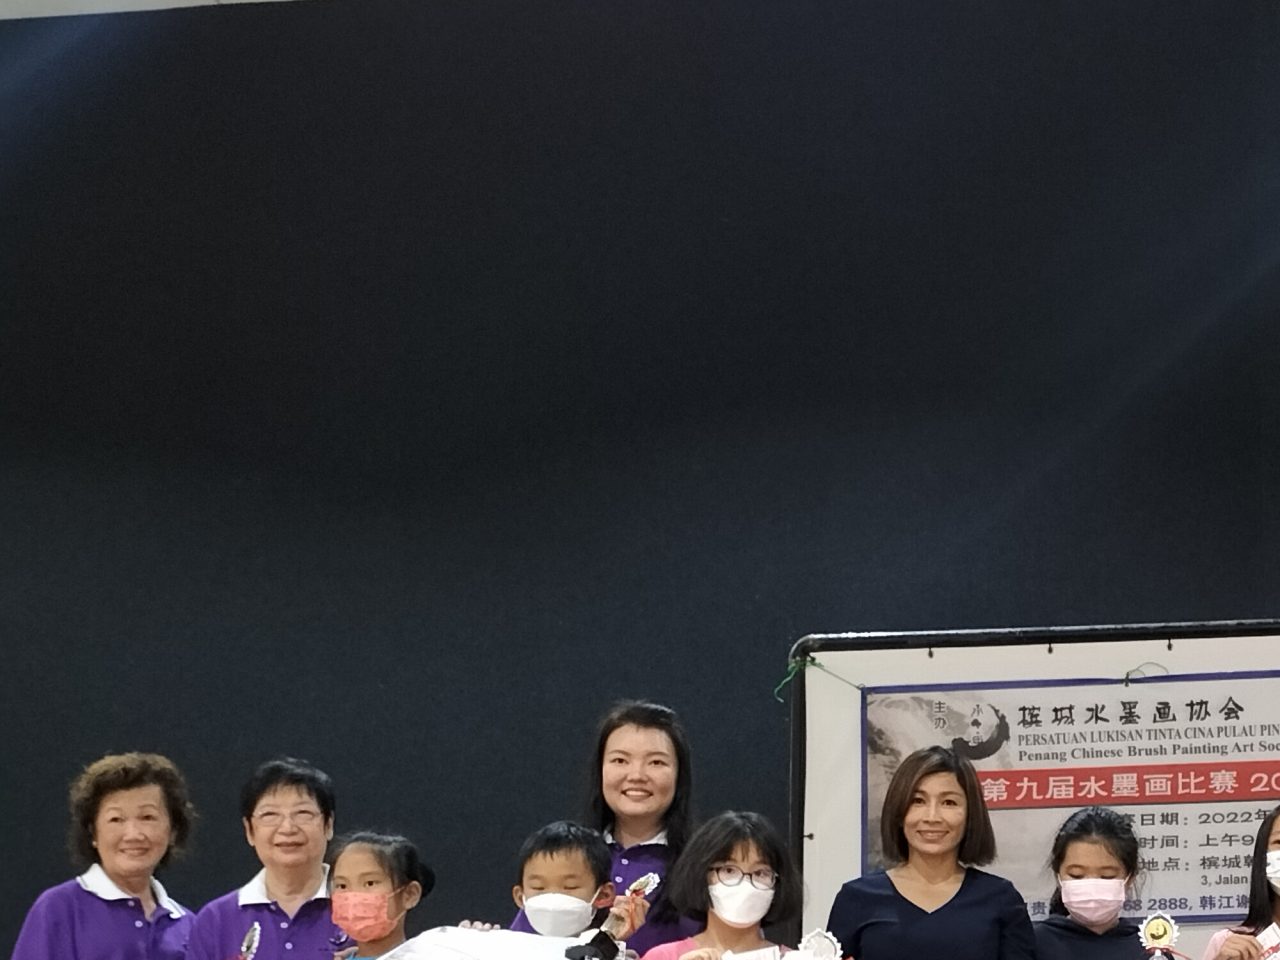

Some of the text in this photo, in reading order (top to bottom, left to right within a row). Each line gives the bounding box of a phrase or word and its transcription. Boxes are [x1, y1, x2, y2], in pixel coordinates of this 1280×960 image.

[933, 700, 949, 730] 主办
[1017, 696, 1245, 729] 槟城水墨画协会
[1018, 731, 1087, 746] PERSATUAN
[1090, 728, 1143, 744] LUKISAN
[1145, 727, 1182, 742] TINTA
[1184, 726, 1214, 740] CINA
[1216, 725, 1257, 739] PULAU
[1018, 750, 1067, 763] Penang
[1071, 747, 1124, 760] Chinese
[1127, 744, 1167, 757] Brush
[1172, 742, 1229, 756] Painting
[1231, 740, 1254, 753] Art
[1201, 874, 1212, 887] 3,
[1215, 874, 1248, 885] Jalan
[1147, 898, 1193, 912] 2888,
